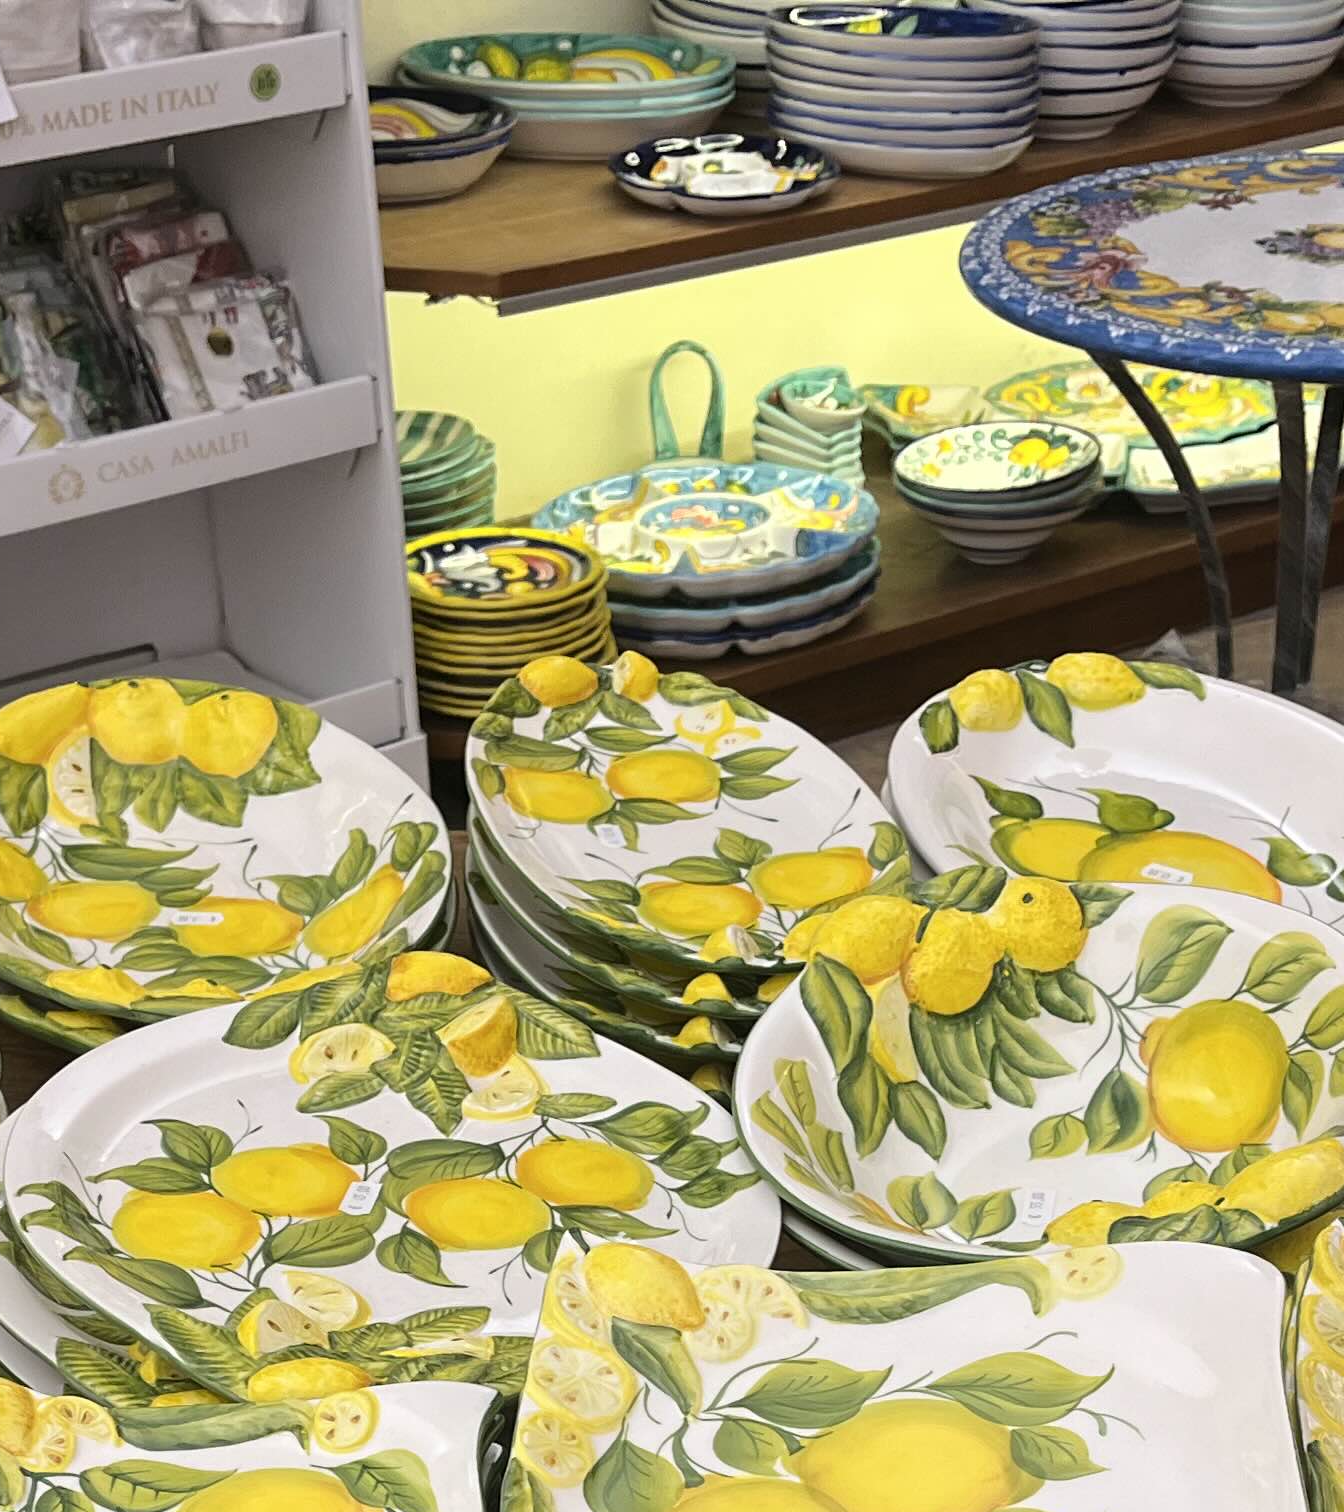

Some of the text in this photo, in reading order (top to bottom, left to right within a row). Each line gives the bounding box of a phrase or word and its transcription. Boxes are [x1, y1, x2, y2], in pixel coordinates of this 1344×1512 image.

[41, 101, 114, 133] MADE
[121, 95, 151, 121] IN
[156, 82, 221, 112] ITALY
[96, 430, 250, 484] CASA AMALFI
